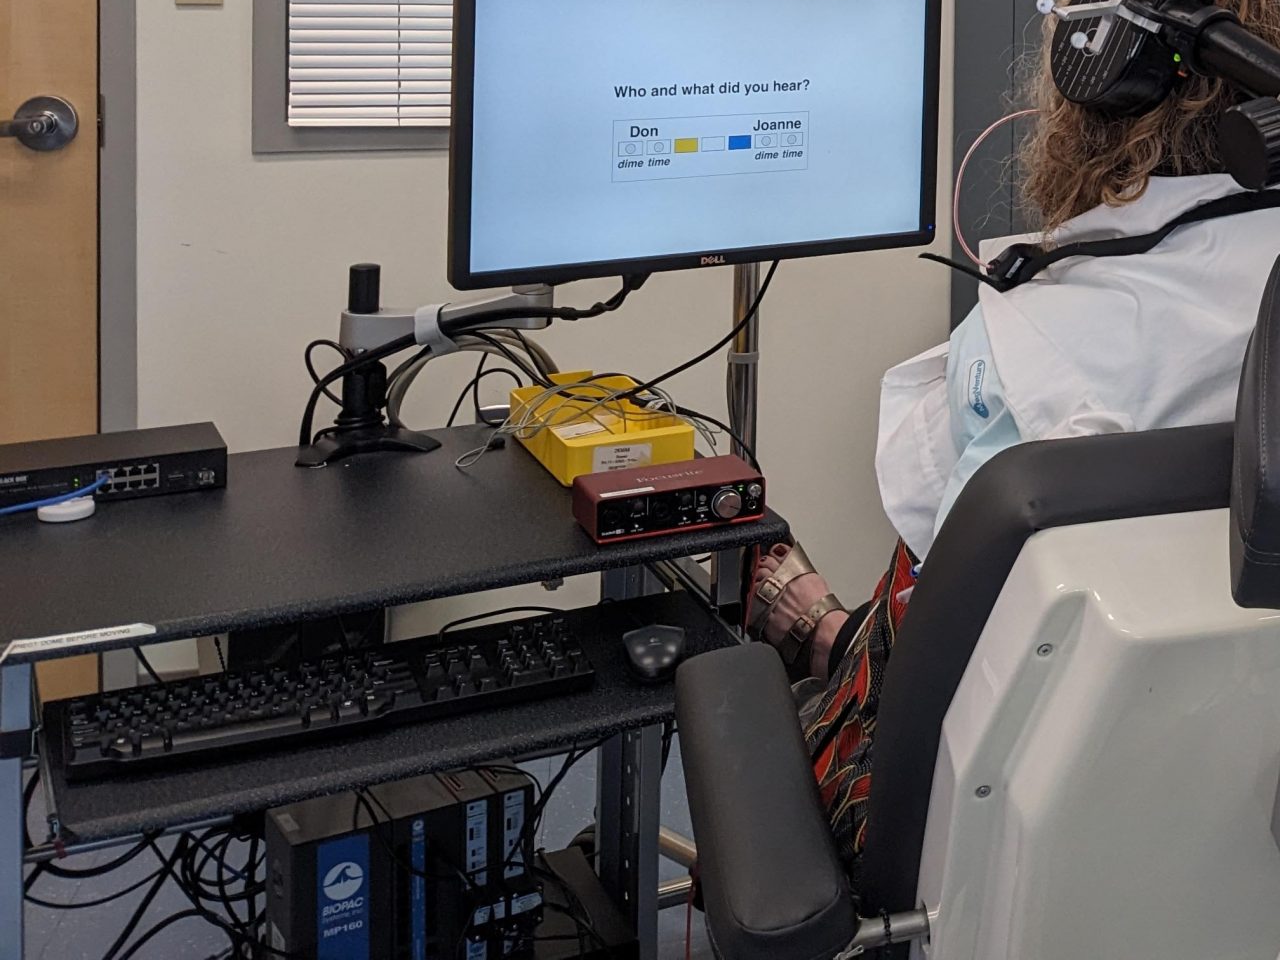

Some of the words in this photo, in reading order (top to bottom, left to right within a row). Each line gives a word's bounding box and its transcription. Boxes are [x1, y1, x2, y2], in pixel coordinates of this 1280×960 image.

[614, 85, 647, 98] Who
[651, 84, 677, 97] and
[681, 82, 715, 96] what
[719, 81, 740, 94] did
[744, 83, 769, 96] you
[773, 79, 810, 92] hear?
[630, 125, 659, 138] Don
[753, 119, 802, 132] Joanne
[754, 150, 779, 160] dime
[782, 149, 804, 158] time
[617, 159, 644, 169] dime
[647, 157, 671, 167] time
[701, 255, 726, 265] DELL
[66, 633, 97, 642] BEFORE
[99, 628, 131, 638] MOVING
[322, 896, 364, 917] BIOPAC
[323, 920, 363, 938] MP160
